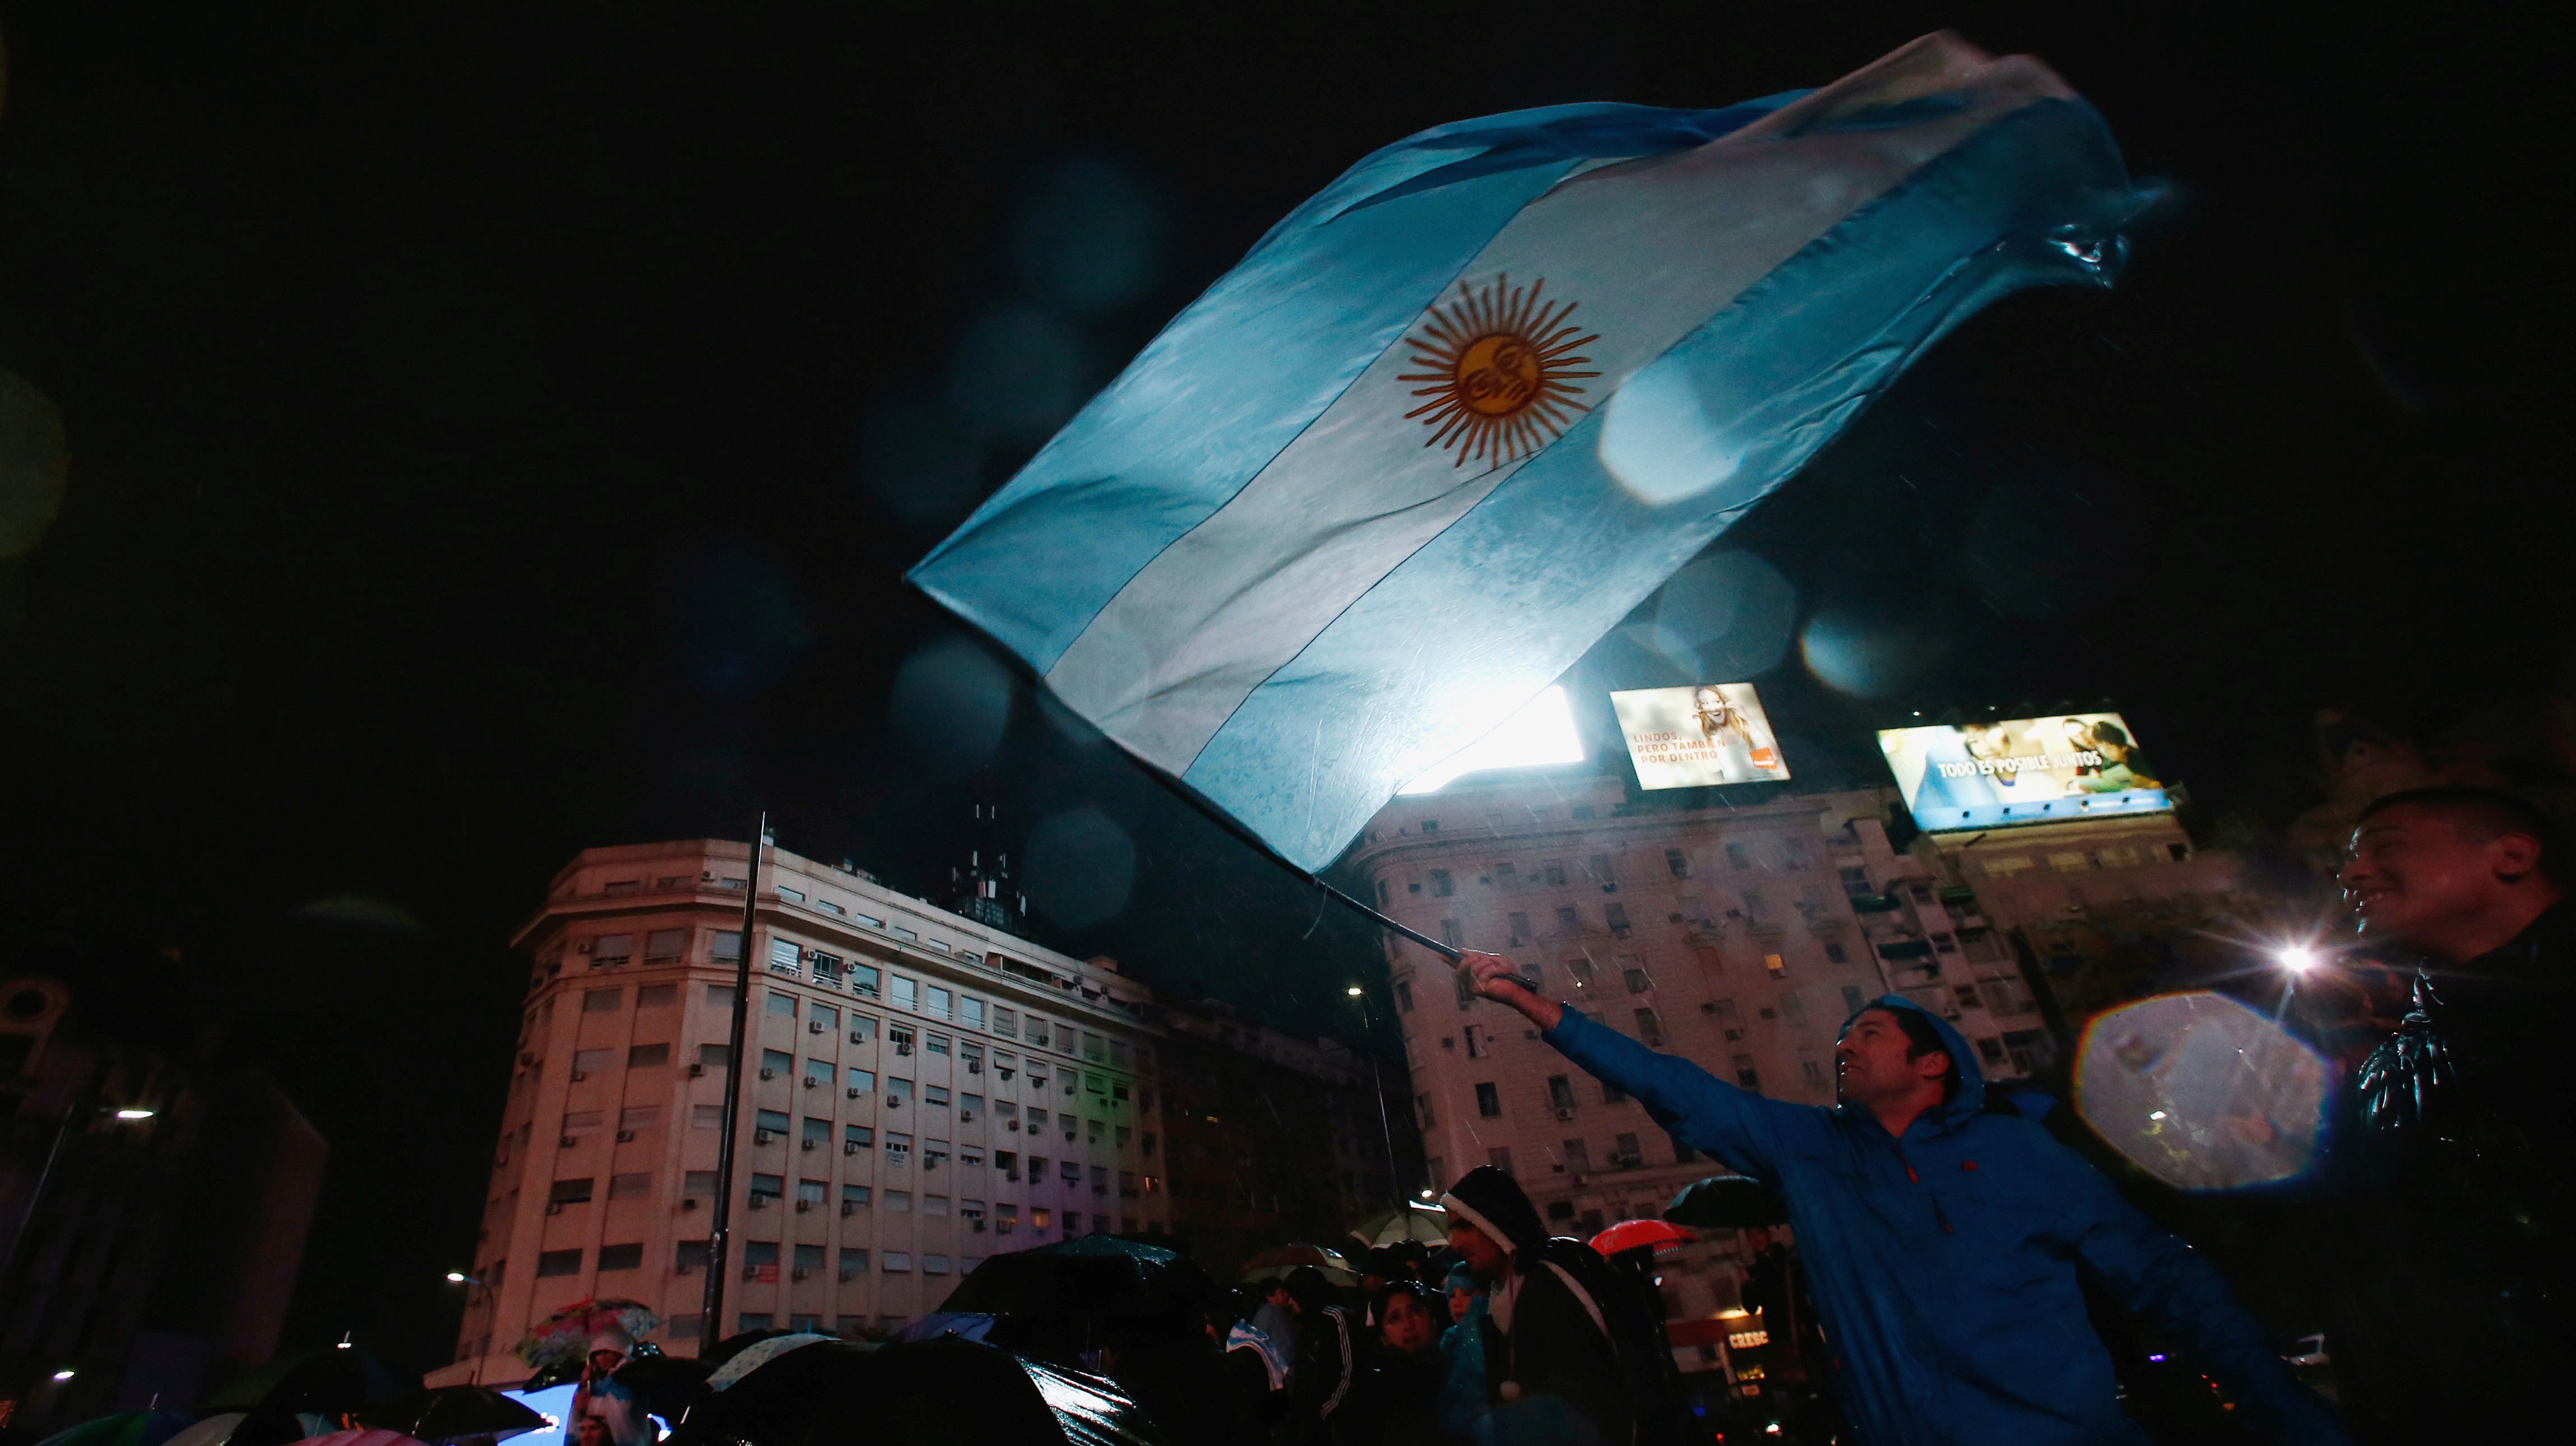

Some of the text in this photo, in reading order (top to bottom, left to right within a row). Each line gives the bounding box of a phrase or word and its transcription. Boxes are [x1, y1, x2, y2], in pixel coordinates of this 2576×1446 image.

[1634, 732, 1681, 743] LINDOS,
[1638, 744, 1668, 753] PERO
[1642, 750, 1717, 763] POR DENTRO
[1938, 750, 2102, 777] TODO ES POSIBLE JUNTOS
